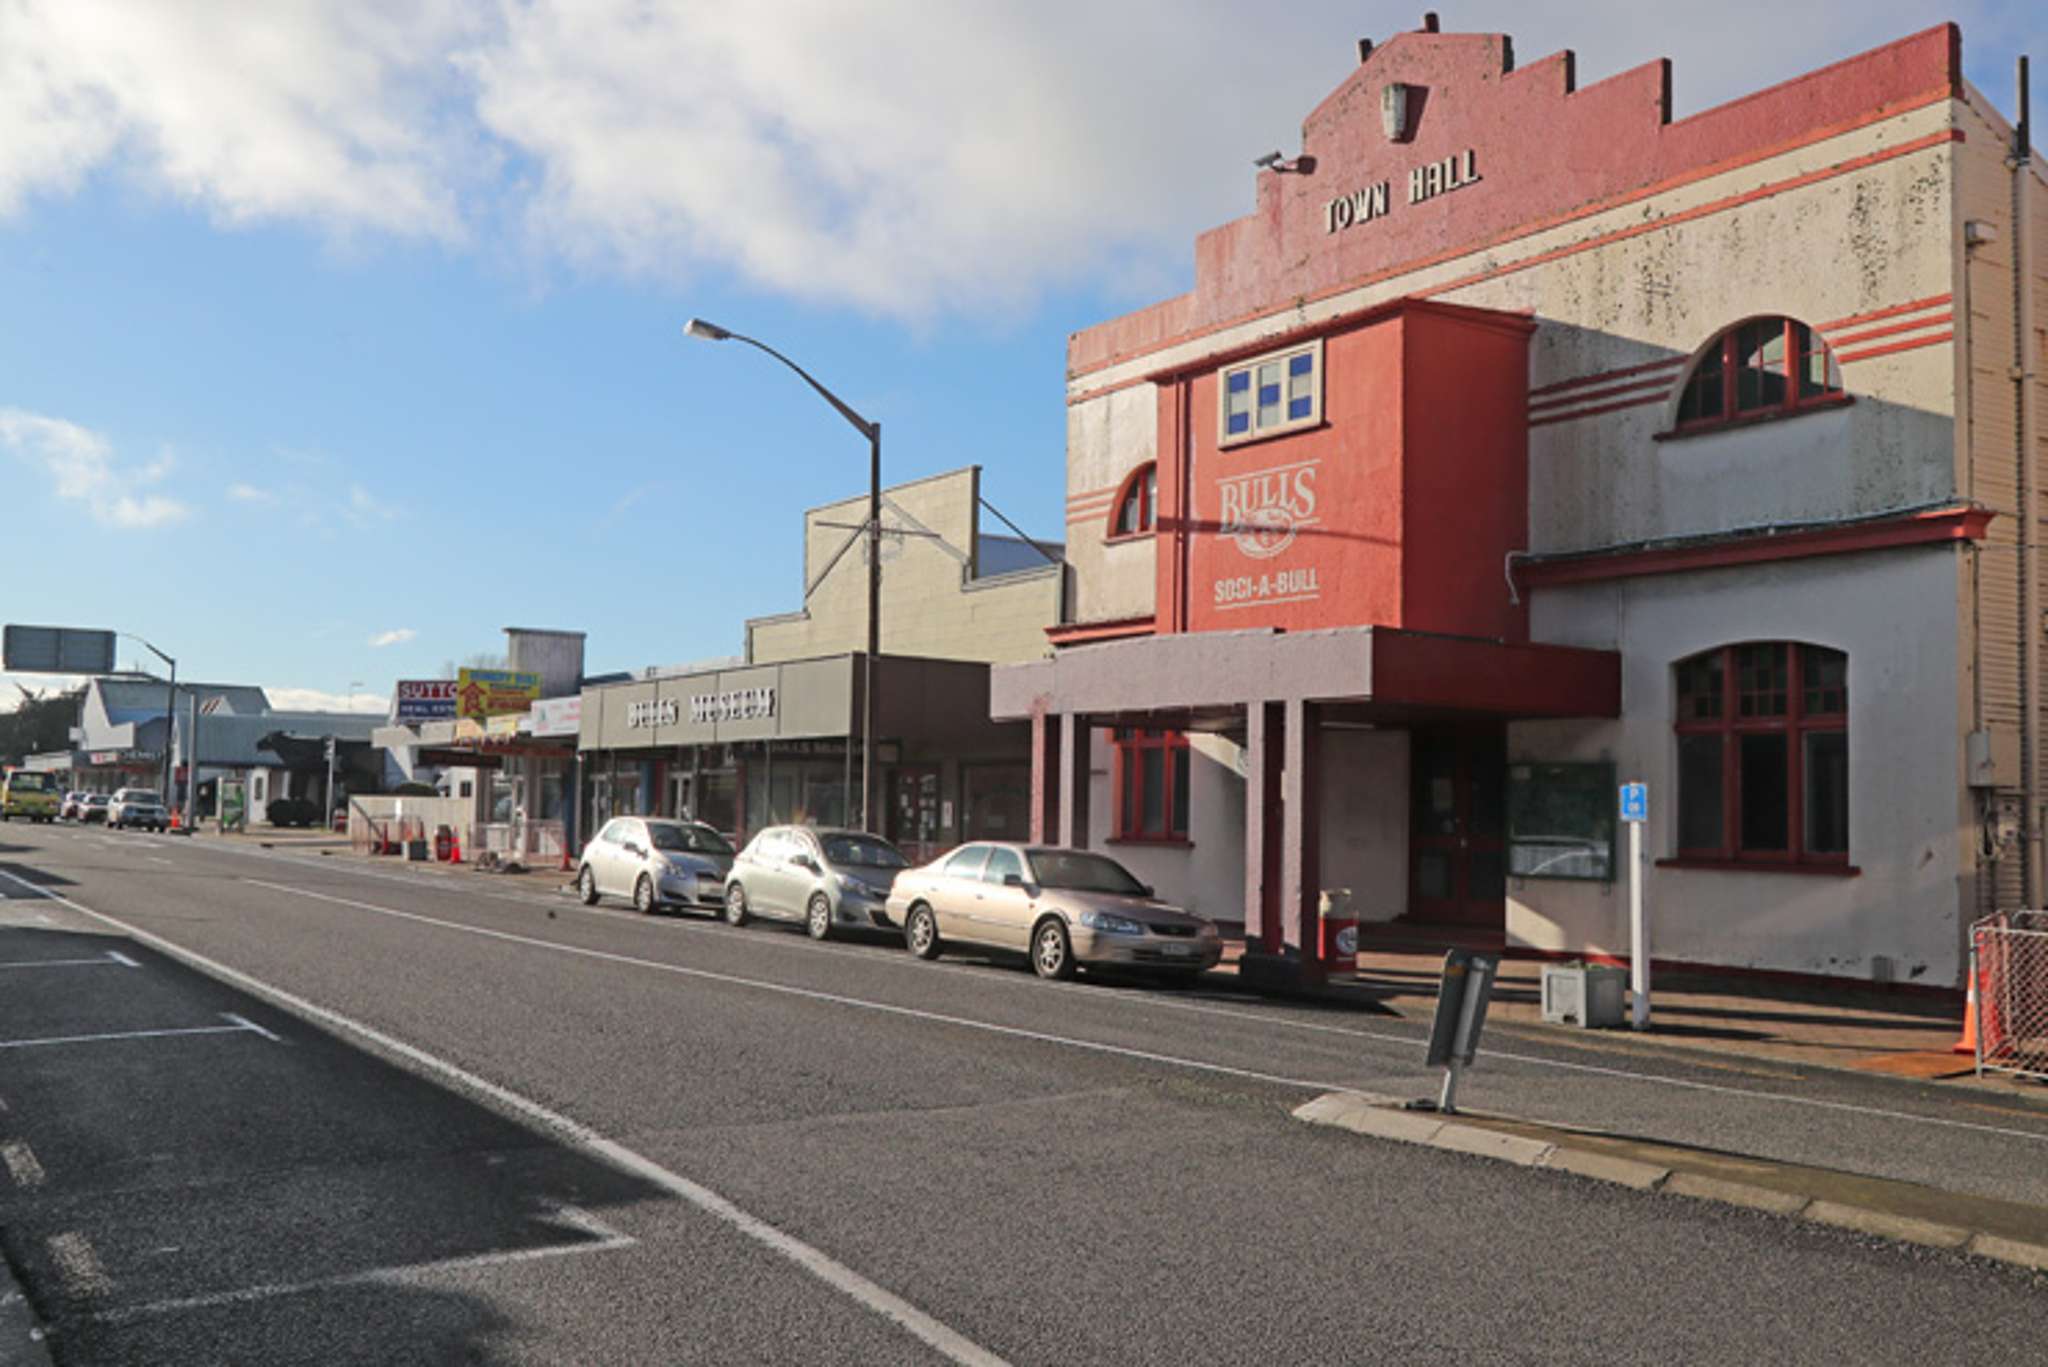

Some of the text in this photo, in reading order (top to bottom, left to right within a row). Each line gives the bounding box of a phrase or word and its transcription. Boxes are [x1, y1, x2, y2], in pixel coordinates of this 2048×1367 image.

[1322, 149, 1481, 234] TOWN HALL
[1220, 466, 1317, 534] BULLS
[628, 688, 775, 729] BULLS MUSEUM
